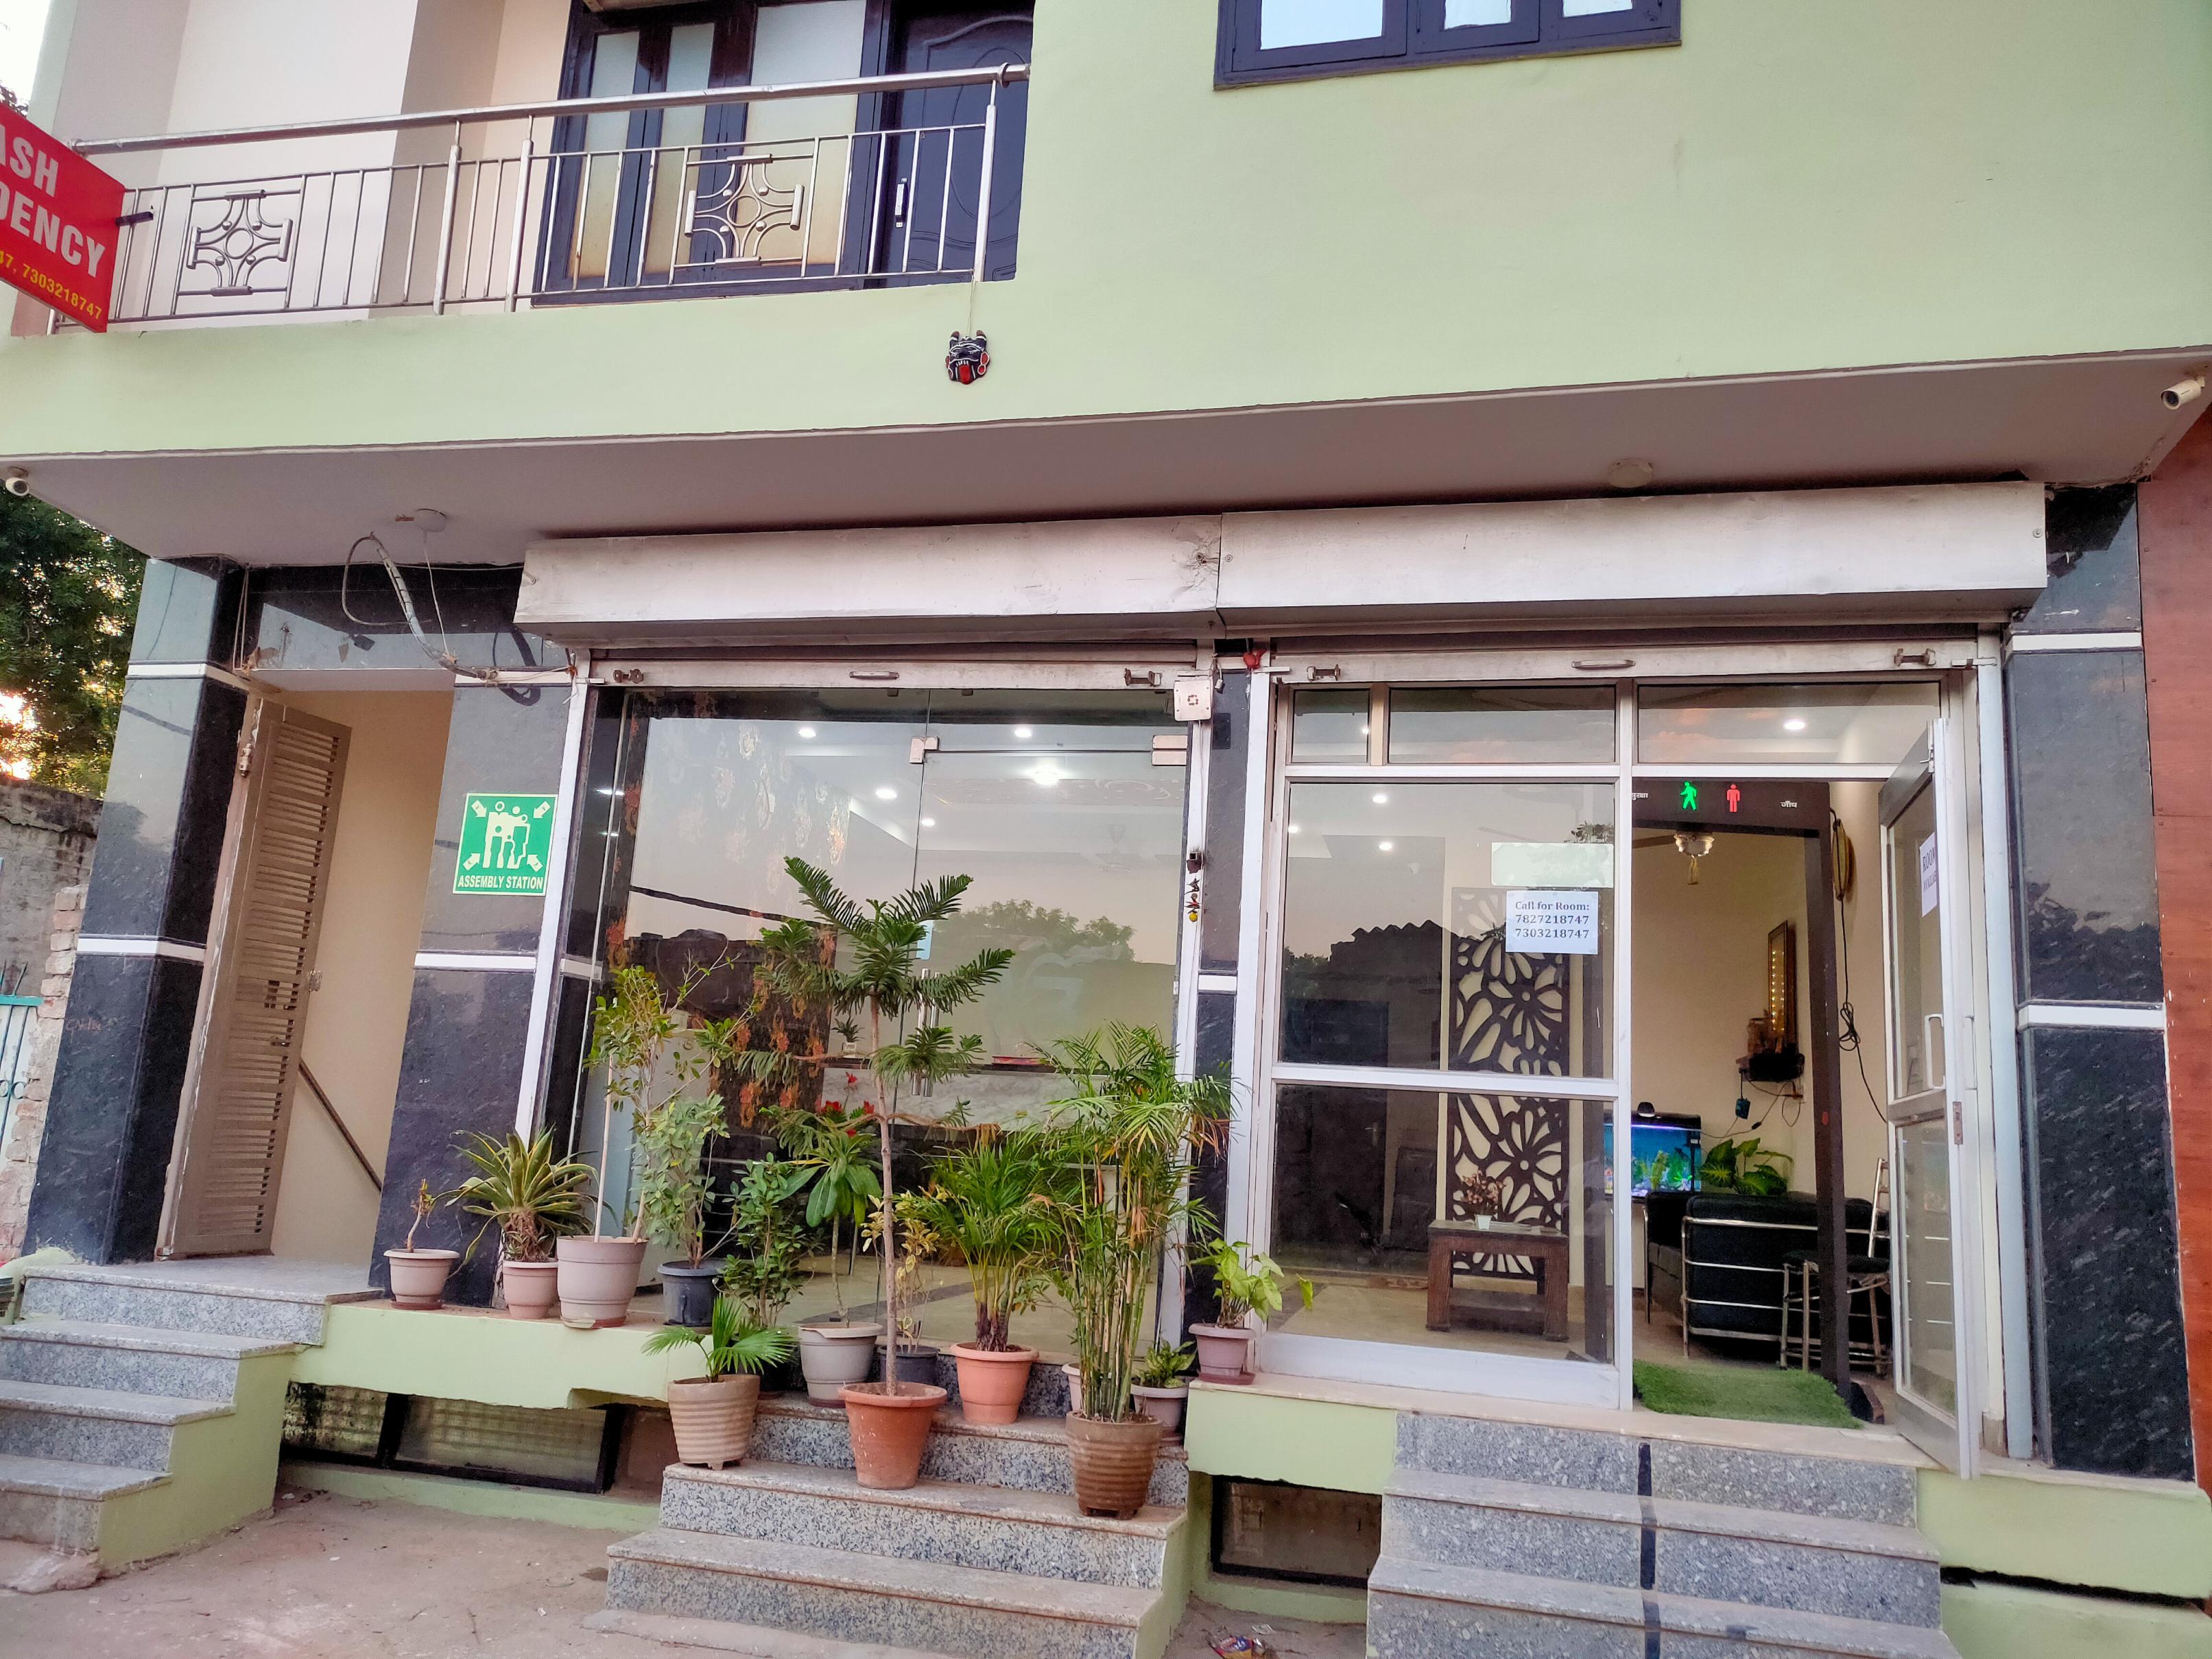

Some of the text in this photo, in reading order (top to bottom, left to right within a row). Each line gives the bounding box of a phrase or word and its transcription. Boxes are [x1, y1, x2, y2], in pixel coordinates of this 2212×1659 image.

[0, 124, 58, 198] SH
[23, 263, 102, 320] 7303218747
[457, 874, 543, 890] ASSEMBLY STATION
[1514, 900, 1590, 911] Call for Room:
[1514, 914, 1590, 924] 7827218747
[1514, 928, 1590, 939] 7303218747
